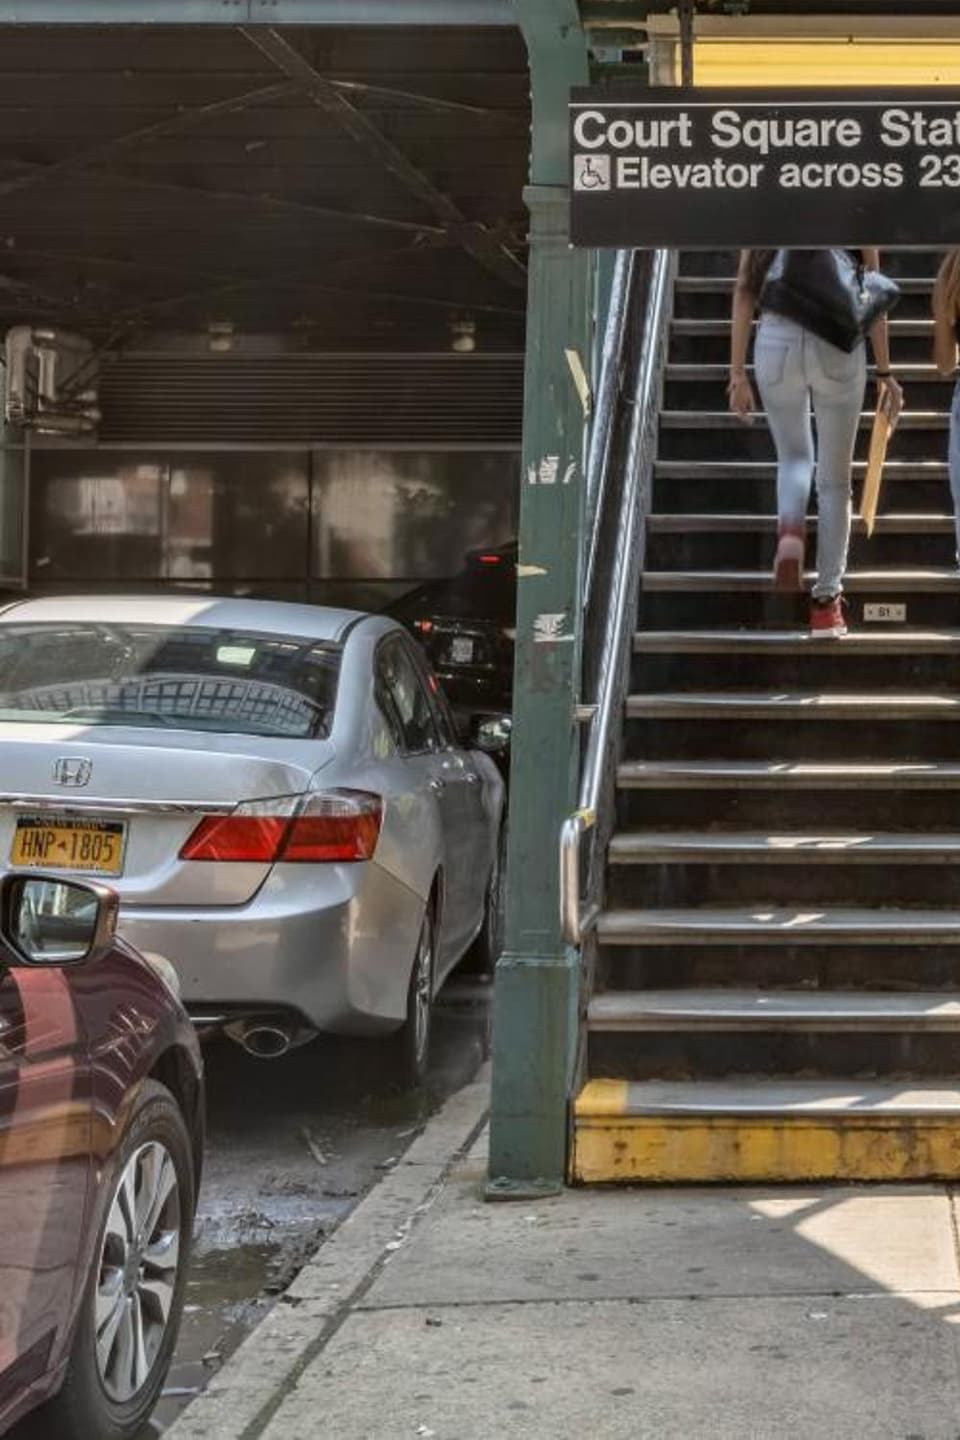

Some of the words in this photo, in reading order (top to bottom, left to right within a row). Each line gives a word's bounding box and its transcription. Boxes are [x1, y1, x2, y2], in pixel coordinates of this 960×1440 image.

[573, 111, 692, 149] Court
[710, 109, 862, 154] Square
[616, 156, 765, 189] Elevator
[778, 162, 904, 188] across
